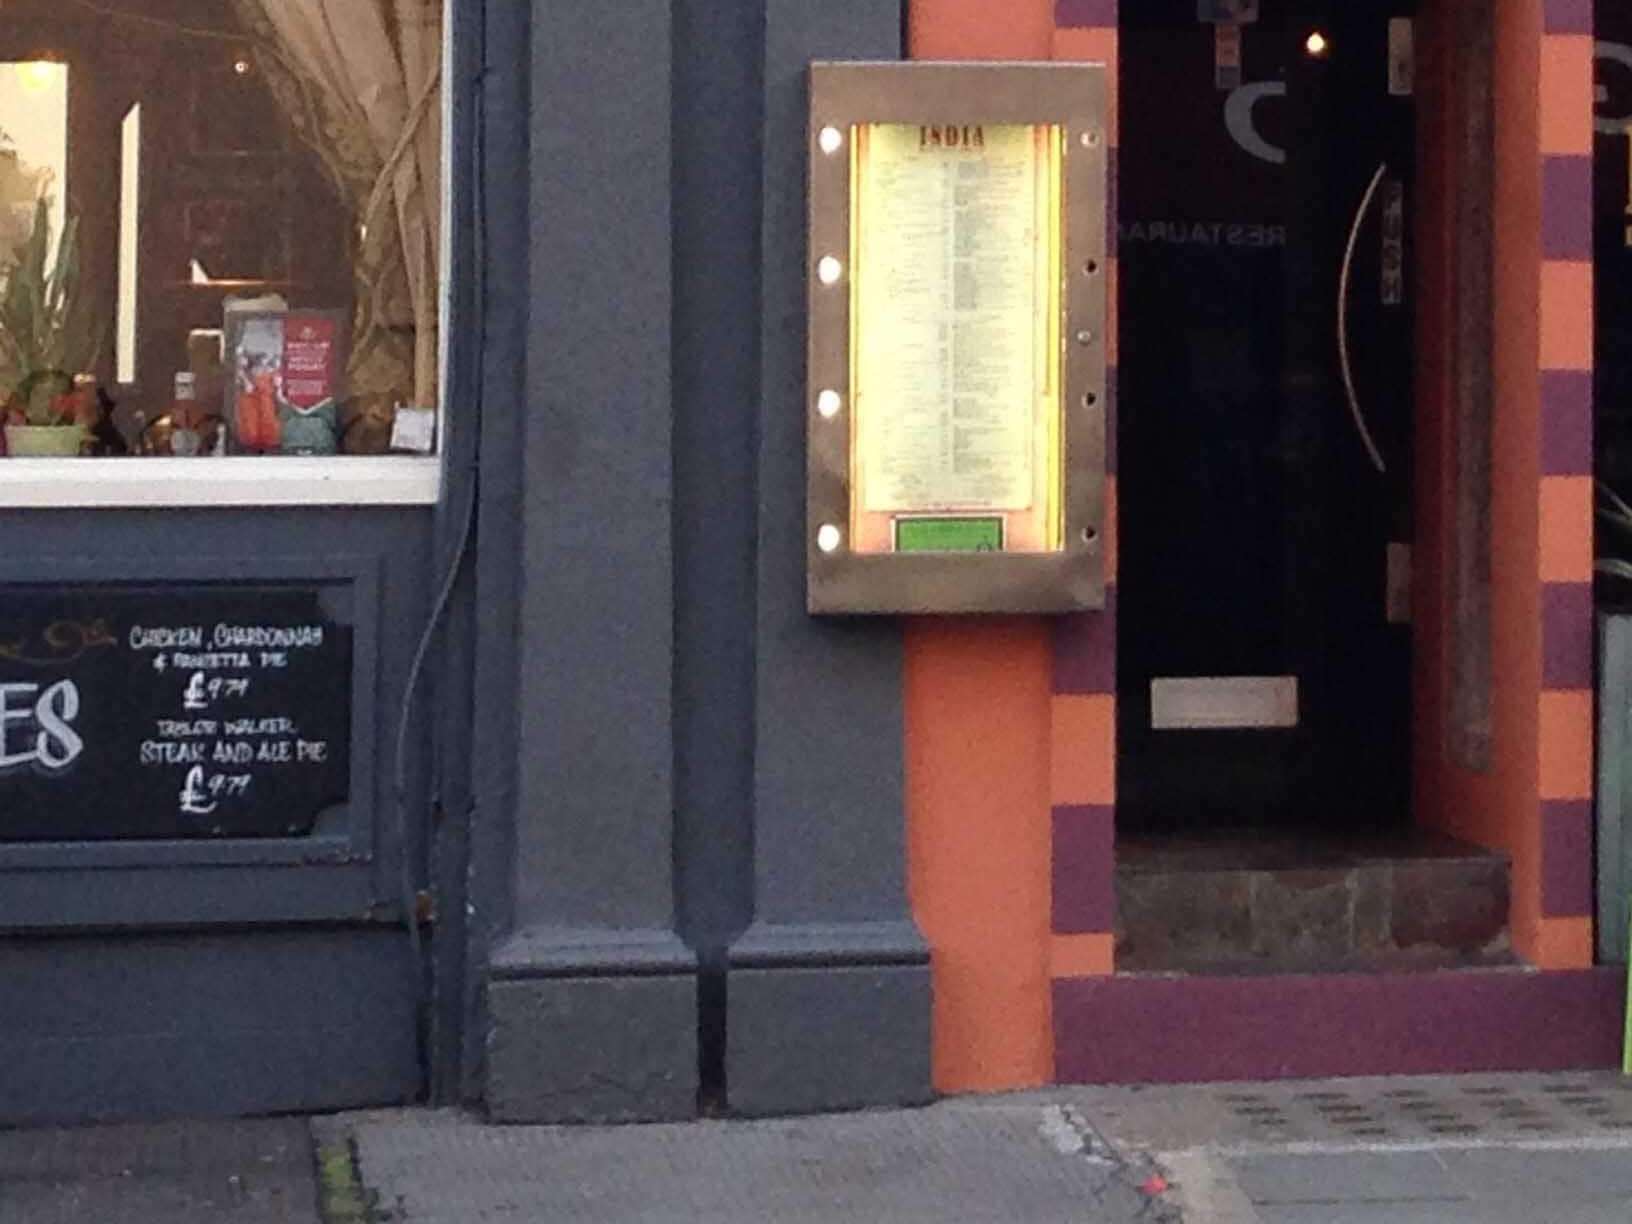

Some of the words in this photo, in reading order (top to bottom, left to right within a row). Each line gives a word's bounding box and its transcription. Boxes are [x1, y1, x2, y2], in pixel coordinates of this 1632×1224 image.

[260, 652, 289, 669] PIE
[140, 740, 206, 764] STEAK
[211, 739, 255, 763] AND
[256, 741, 293, 763] ALE
[296, 738, 328, 763] PIE
